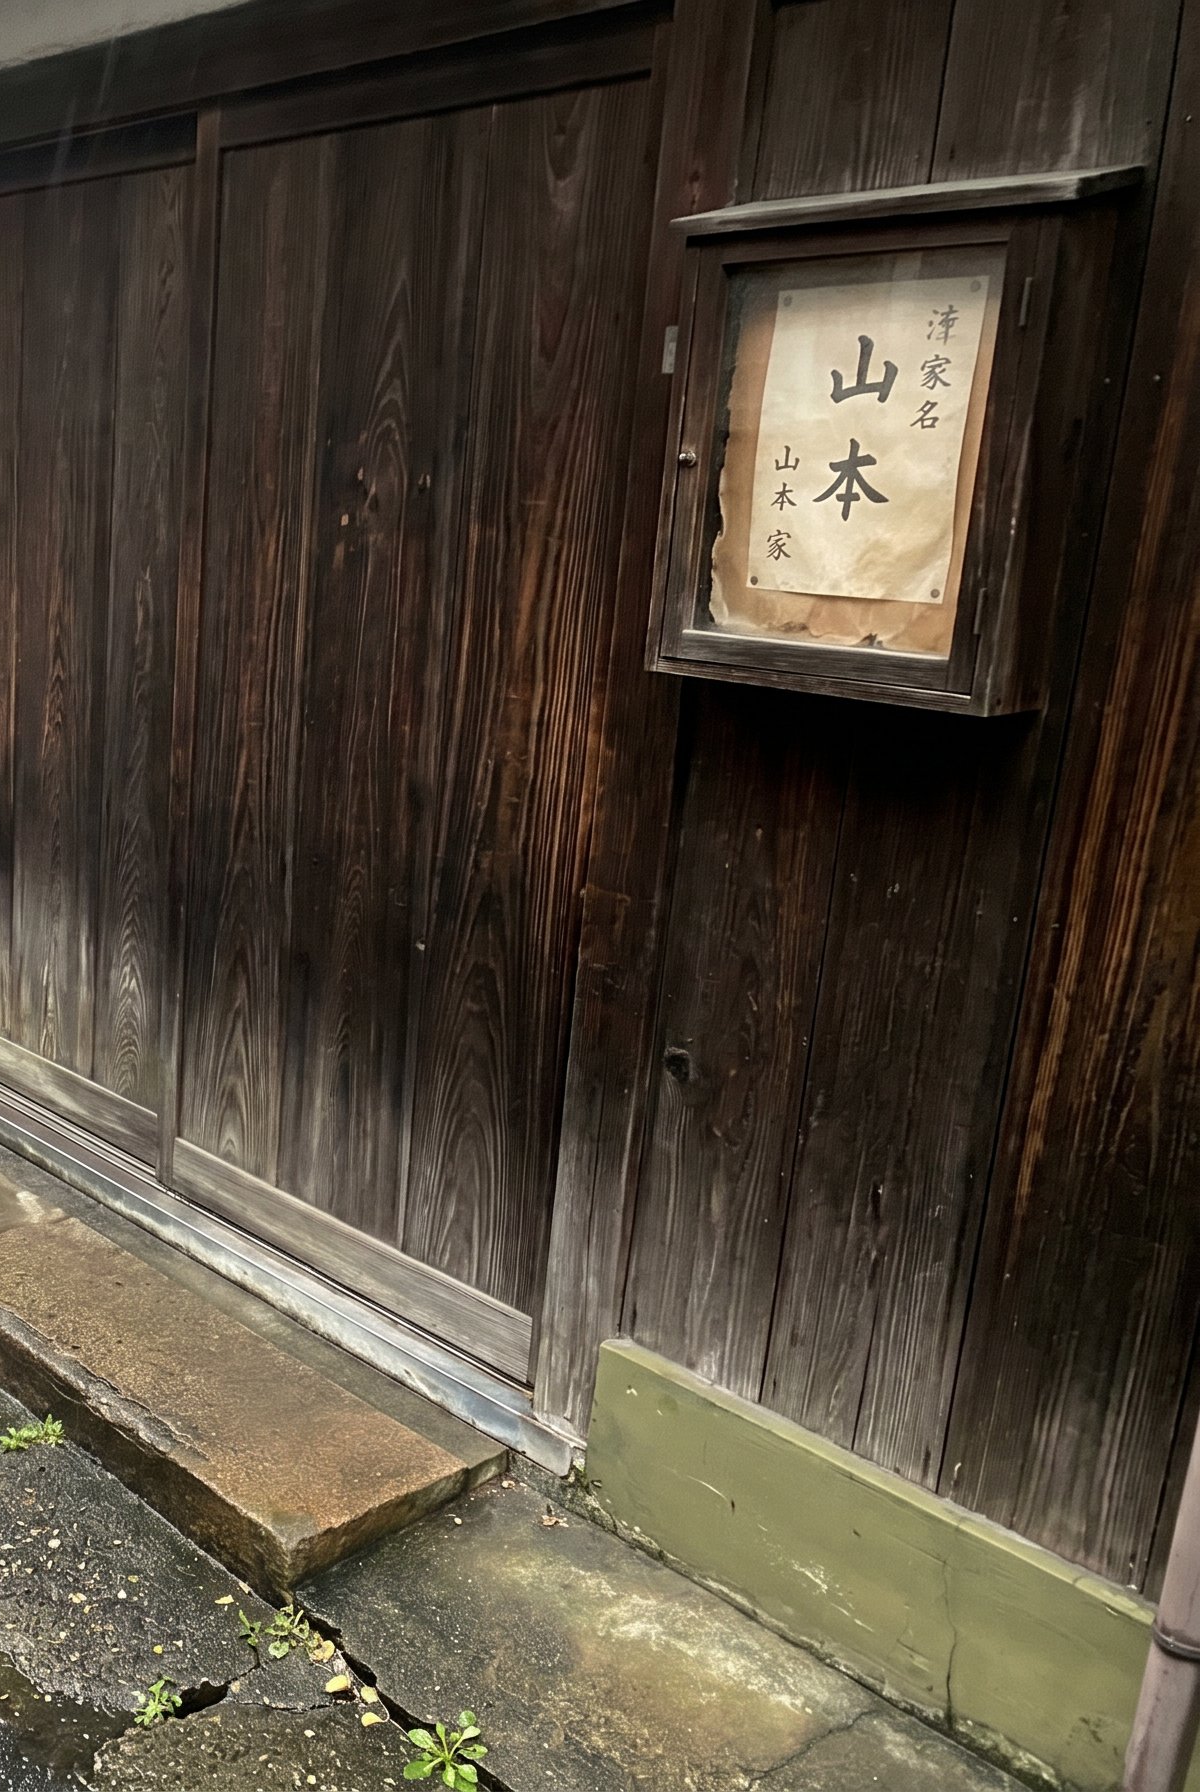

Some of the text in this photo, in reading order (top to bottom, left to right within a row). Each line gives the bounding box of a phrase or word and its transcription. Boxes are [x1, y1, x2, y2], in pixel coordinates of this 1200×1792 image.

[766, 445, 801, 561] 山本家
[811, 335, 899, 522] 山本
